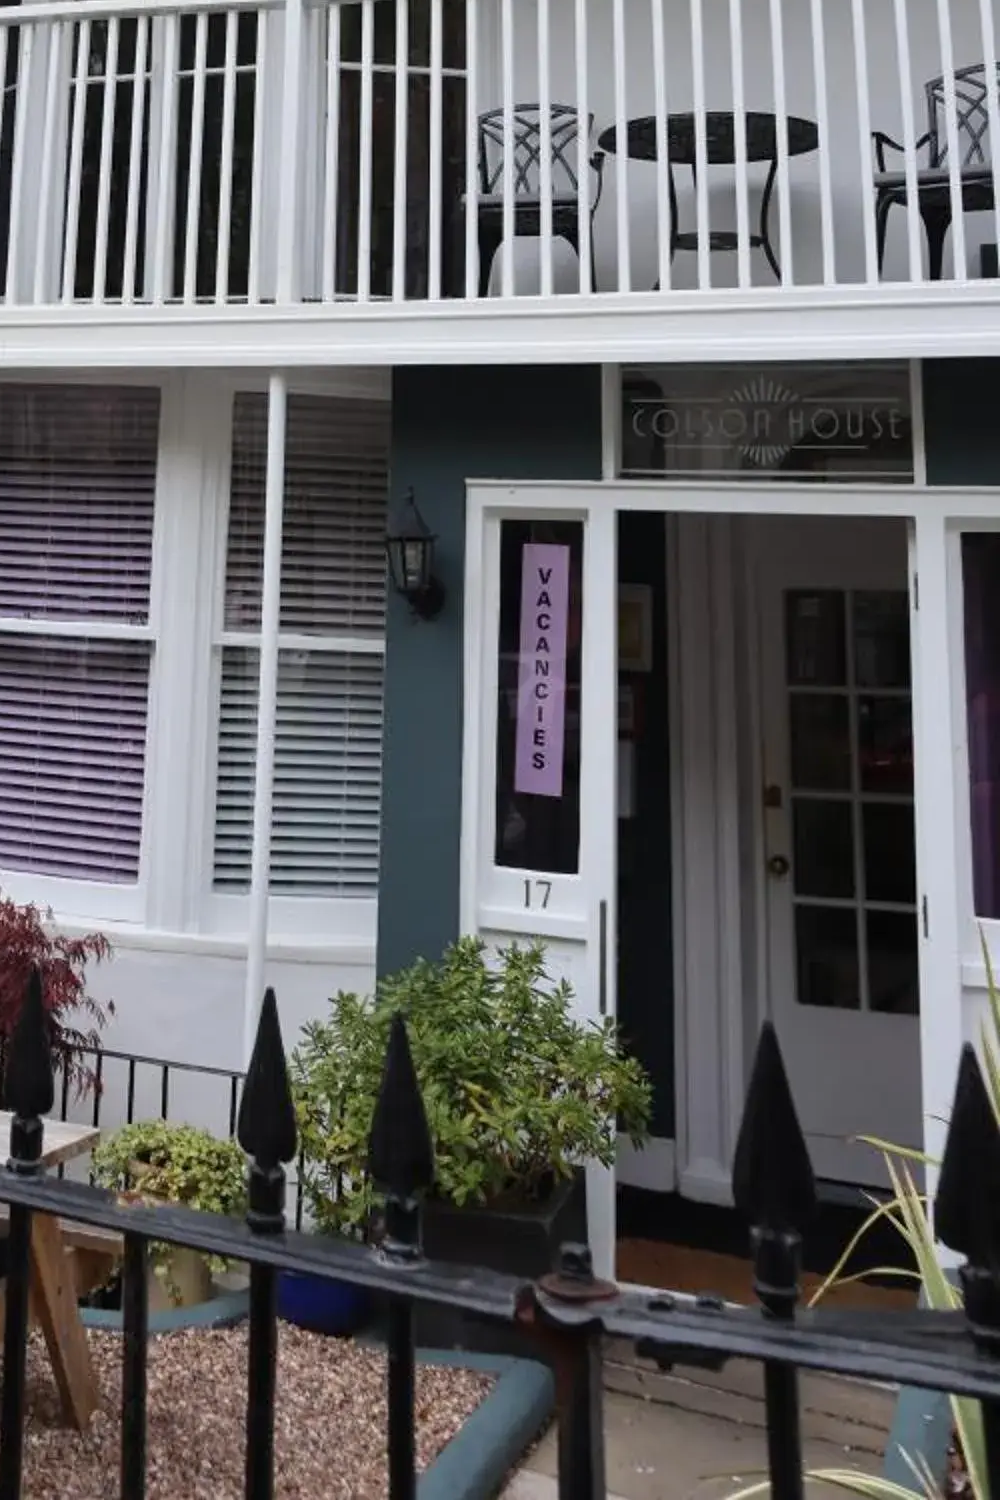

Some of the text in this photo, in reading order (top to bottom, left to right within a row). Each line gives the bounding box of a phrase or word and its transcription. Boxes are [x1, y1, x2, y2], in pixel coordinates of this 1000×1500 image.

[632, 406, 904, 439] COLSON HOUSE
[531, 567, 553, 771] VACANCIES
[523, 880, 553, 909] 17
